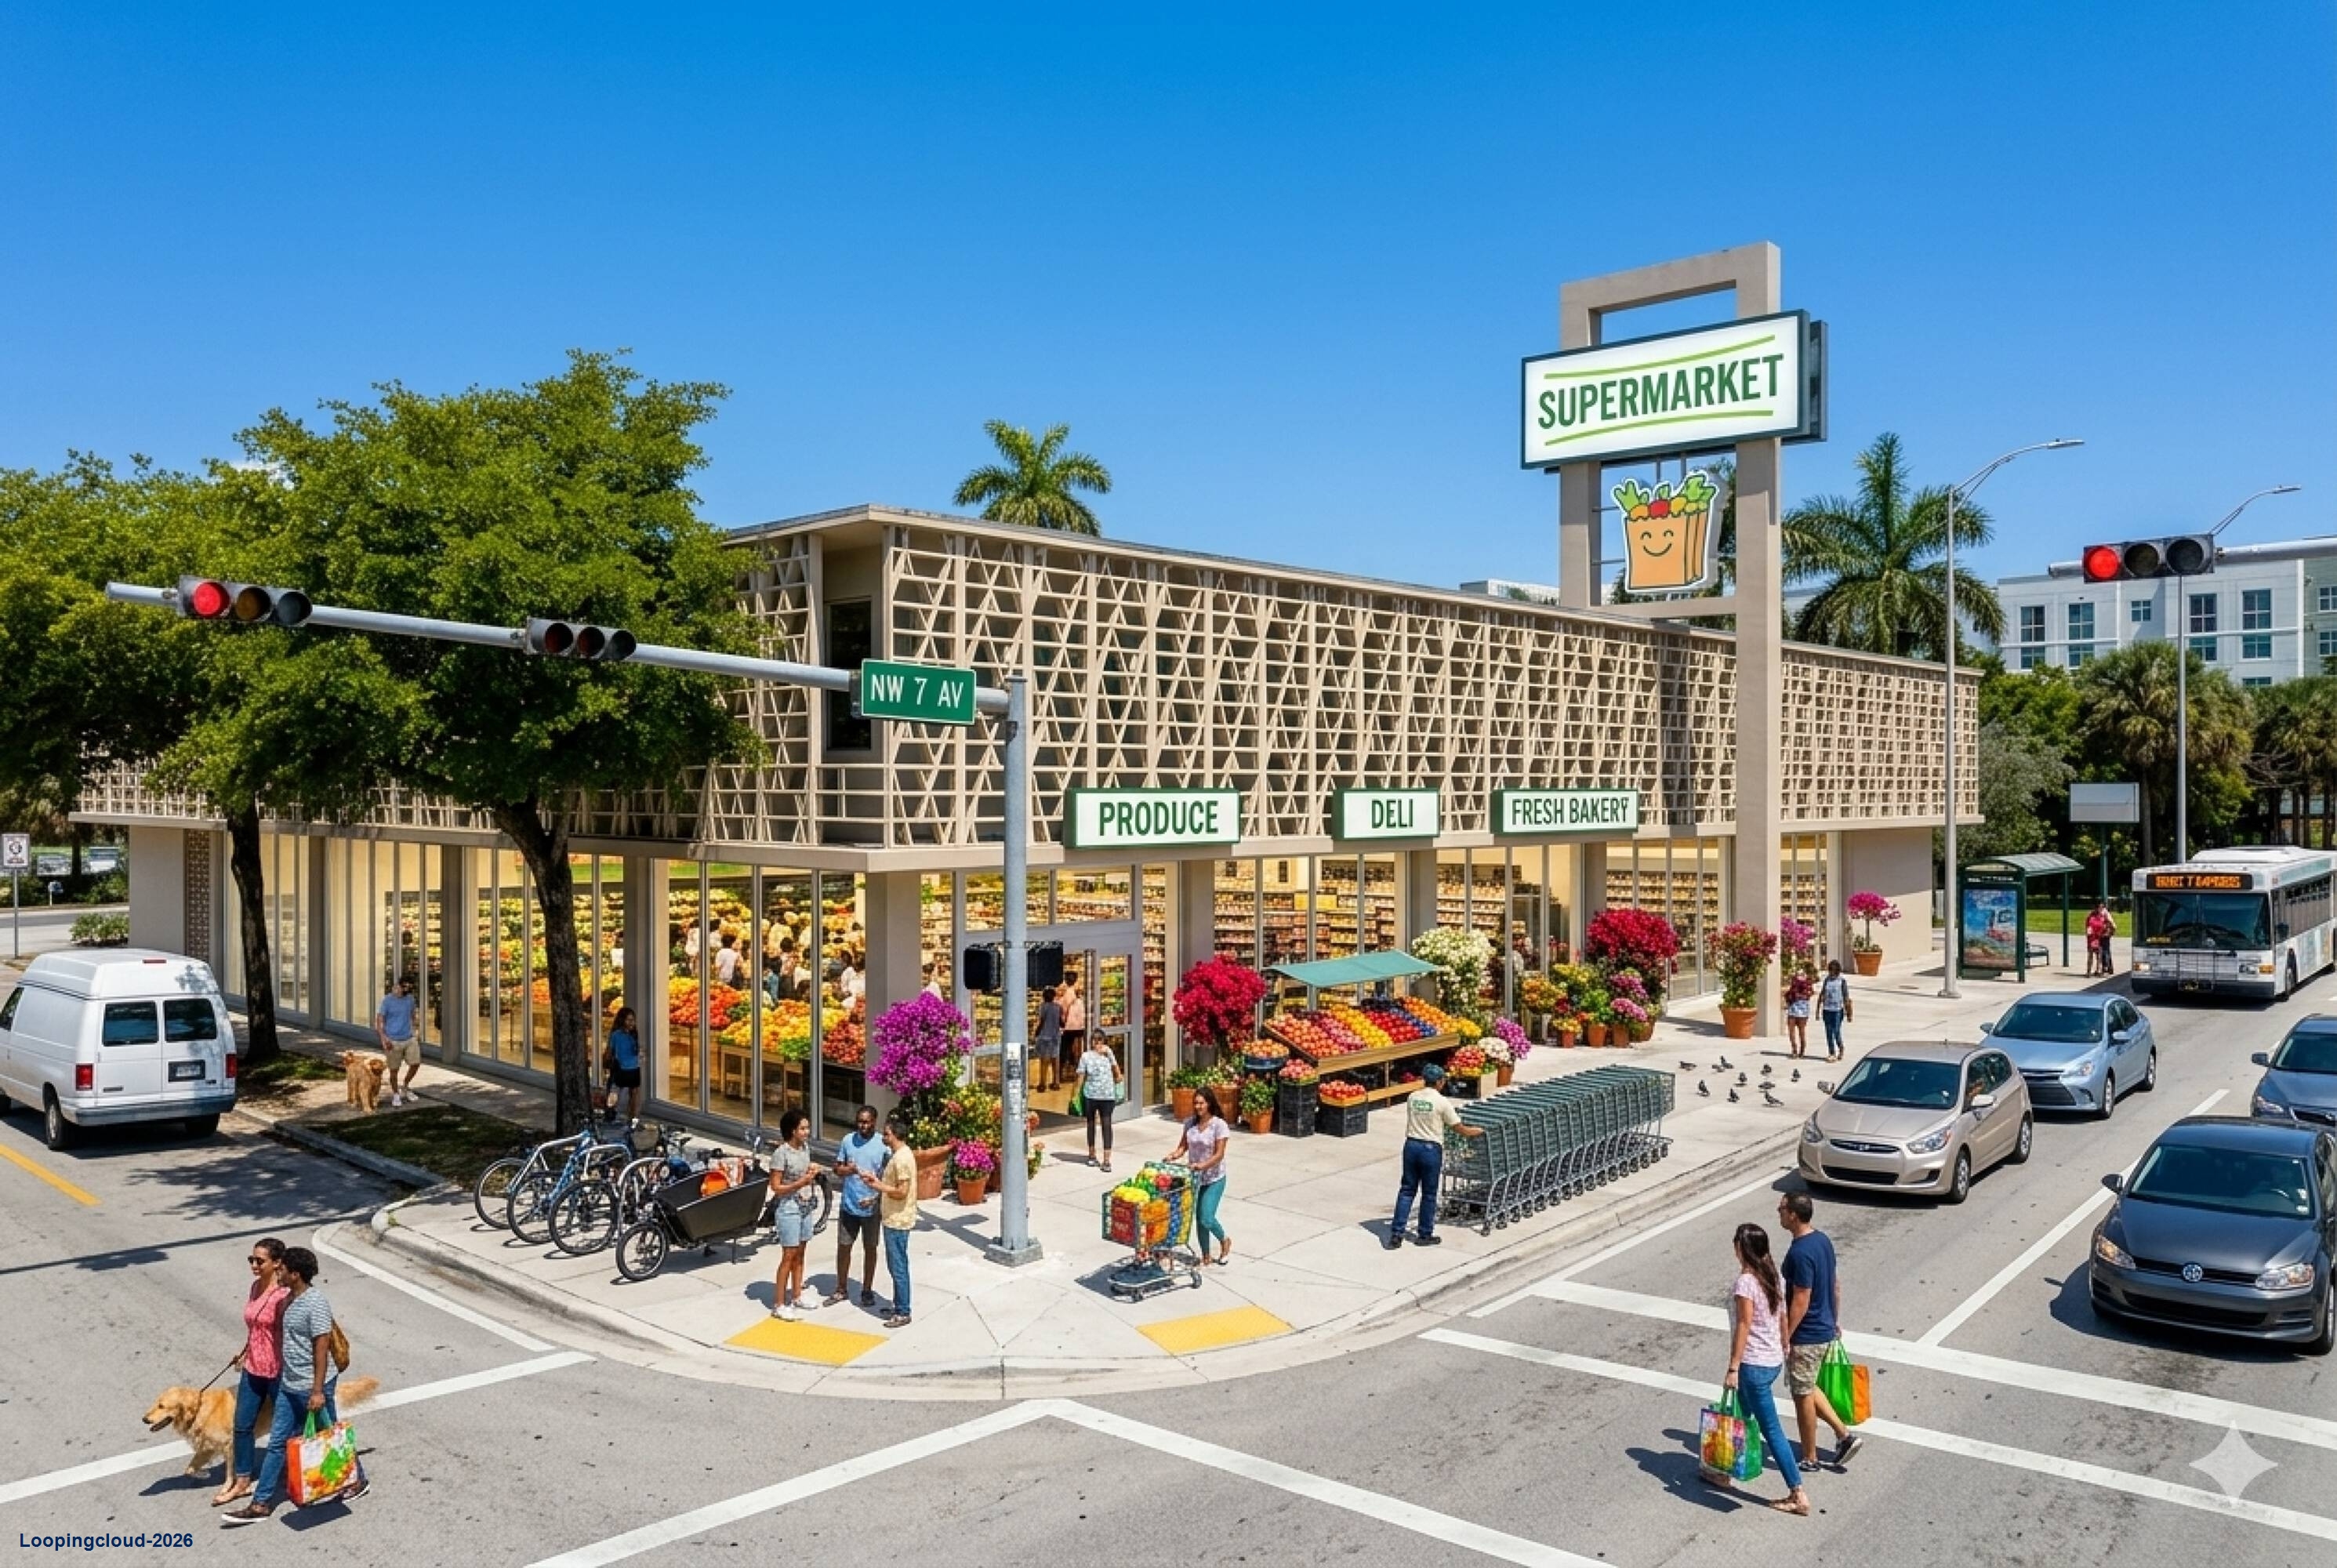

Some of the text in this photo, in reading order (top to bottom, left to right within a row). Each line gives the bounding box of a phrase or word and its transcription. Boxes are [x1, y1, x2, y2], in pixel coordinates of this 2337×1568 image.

[1537, 353, 1784, 430] SUPERMARKET
[870, 674, 964, 709] NW 7 AV
[1099, 800, 1219, 837] PRODUCE
[1370, 798, 1413, 829] DELI
[1511, 797, 1630, 826] FRESH BAKERY
